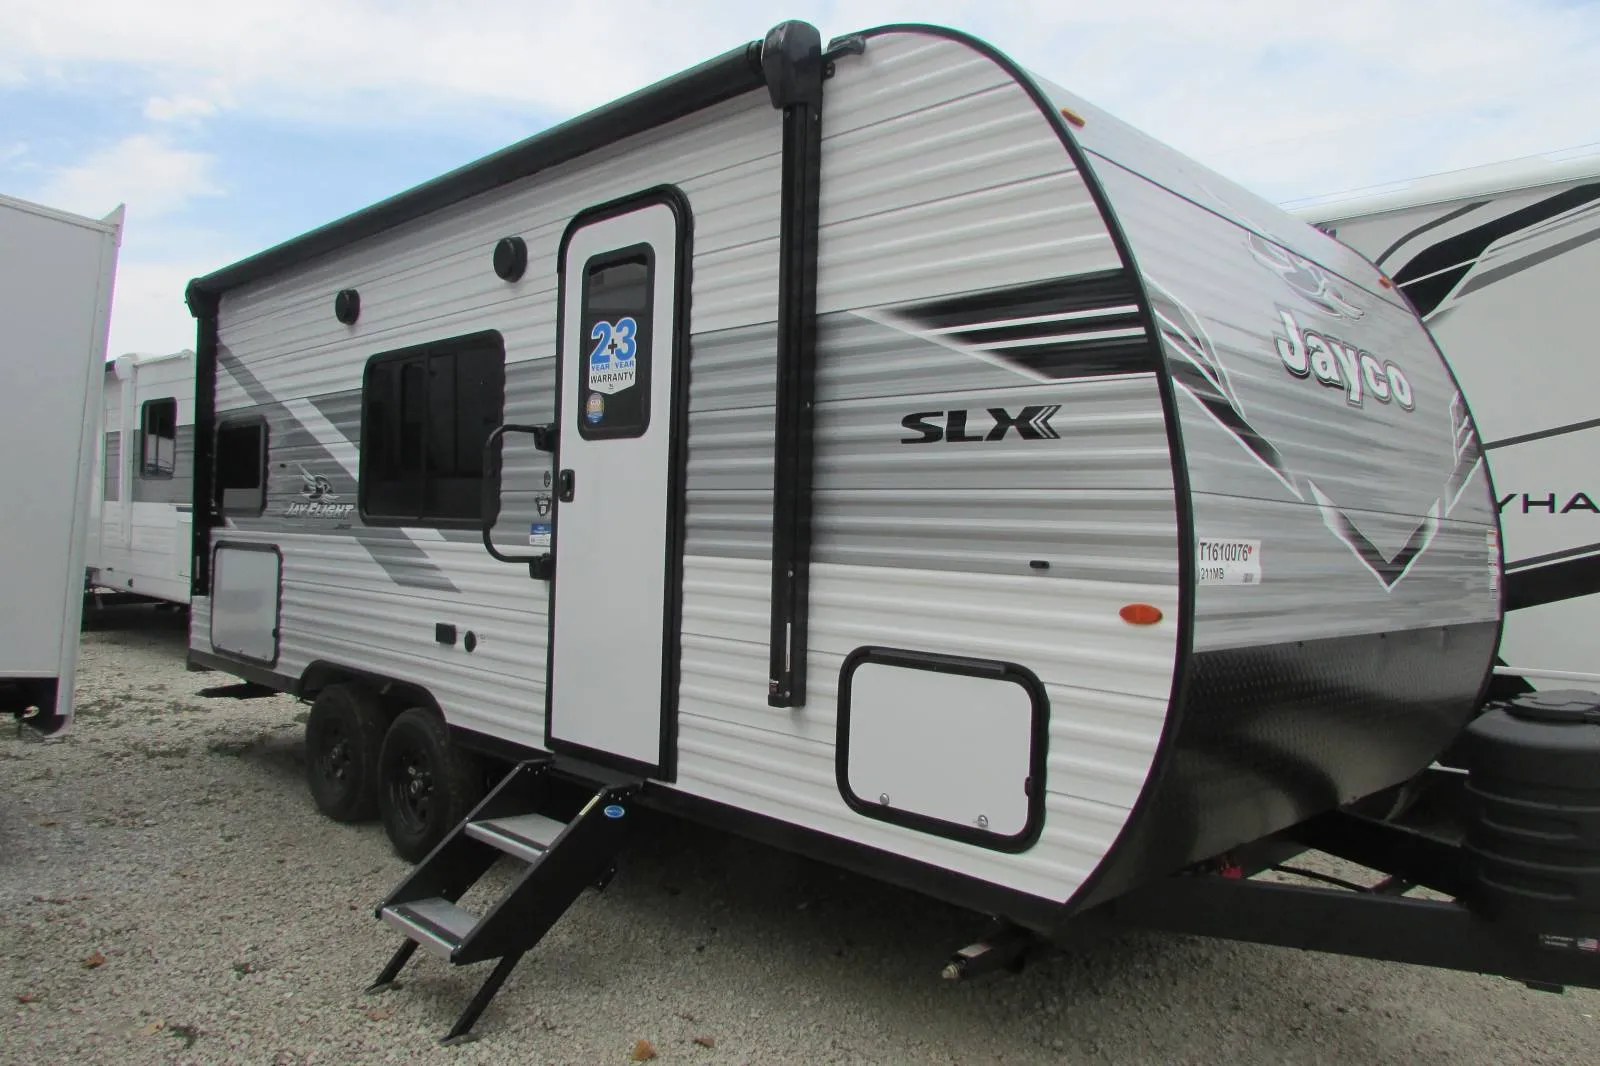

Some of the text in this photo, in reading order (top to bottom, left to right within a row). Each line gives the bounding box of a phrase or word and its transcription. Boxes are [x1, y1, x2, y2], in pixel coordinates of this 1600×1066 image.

[591, 361, 635, 372] YEAR YEAR
[1273, 308, 1415, 412] Jayco
[590, 372, 634, 384] WARRANTY
[901, 405, 1061, 444] SLX
[1200, 542, 1248, 561] T1610076
[1201, 567, 1224, 580] 211MB
